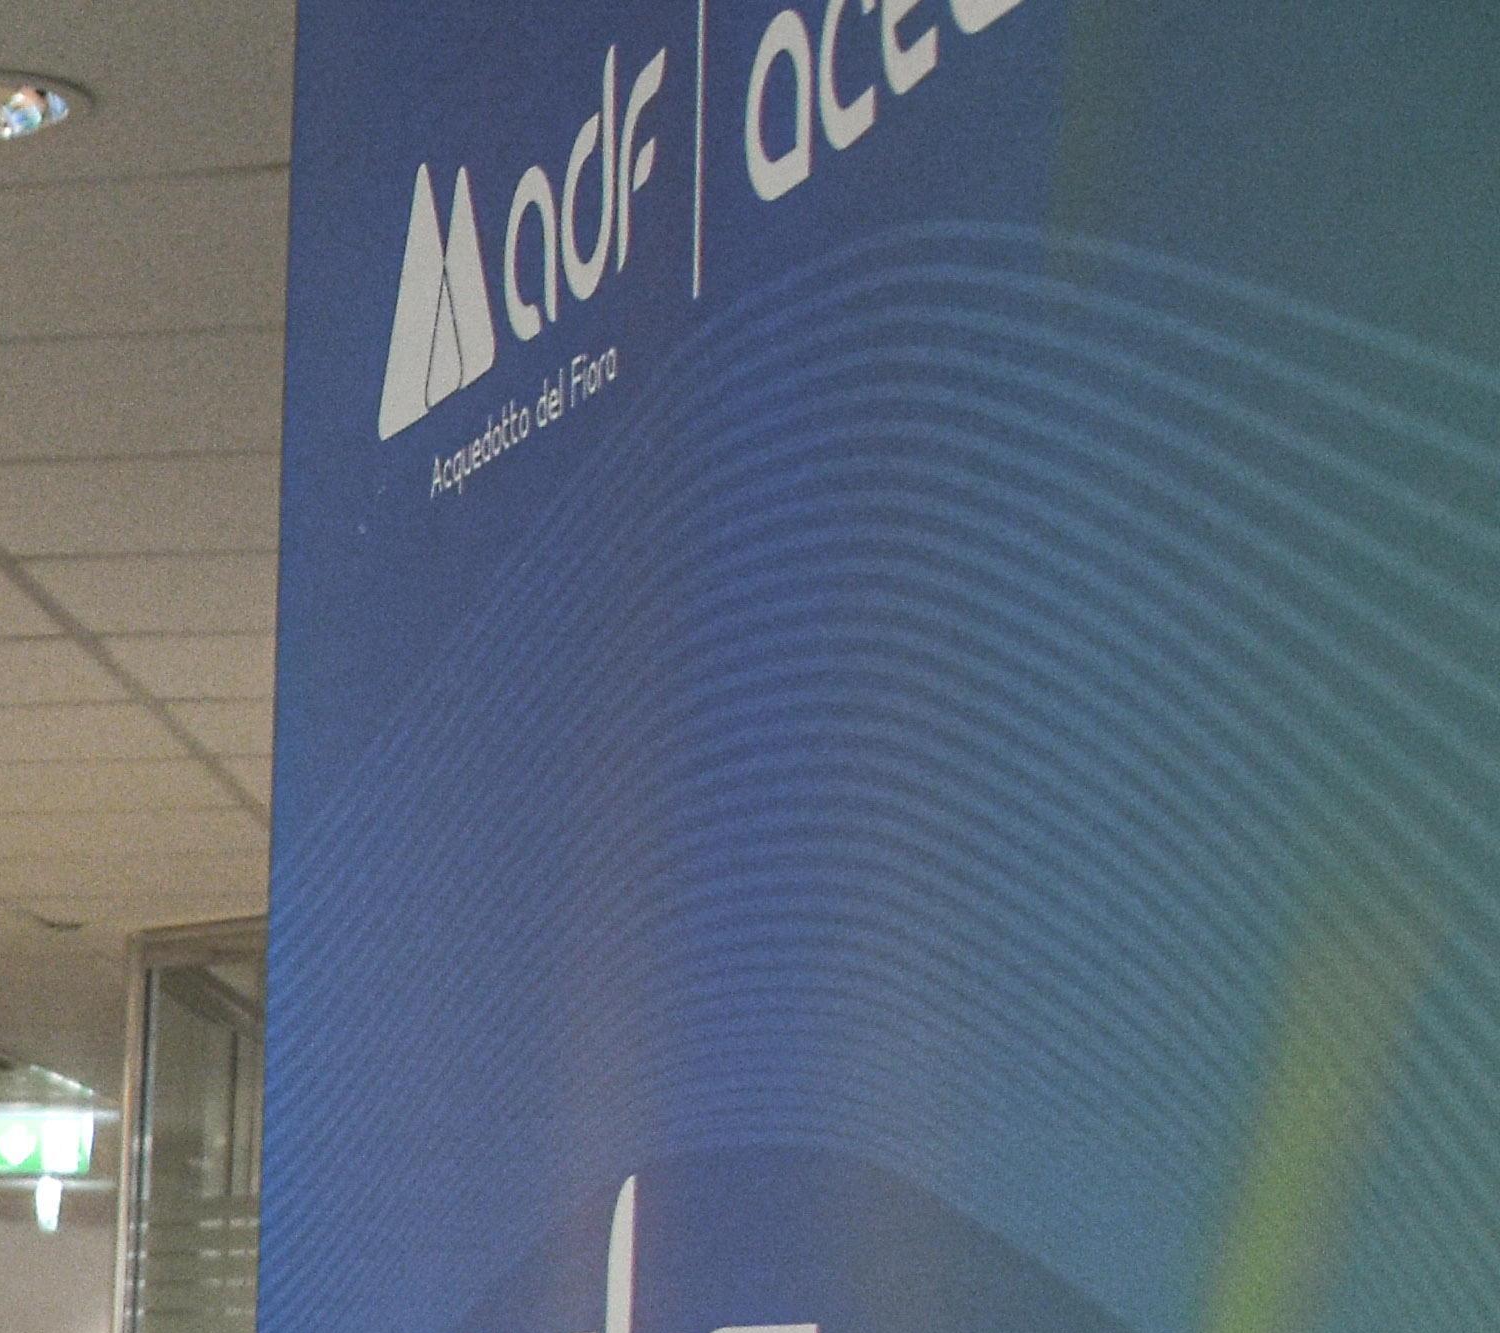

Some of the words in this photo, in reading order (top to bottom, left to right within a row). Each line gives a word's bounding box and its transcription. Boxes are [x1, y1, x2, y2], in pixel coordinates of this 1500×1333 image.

[504, 44, 666, 343] adf
[745, 0, 1026, 202] ace
[430, 400, 530, 499] Acquedotto
[536, 367, 564, 429] del
[570, 347, 618, 408] Fiora
